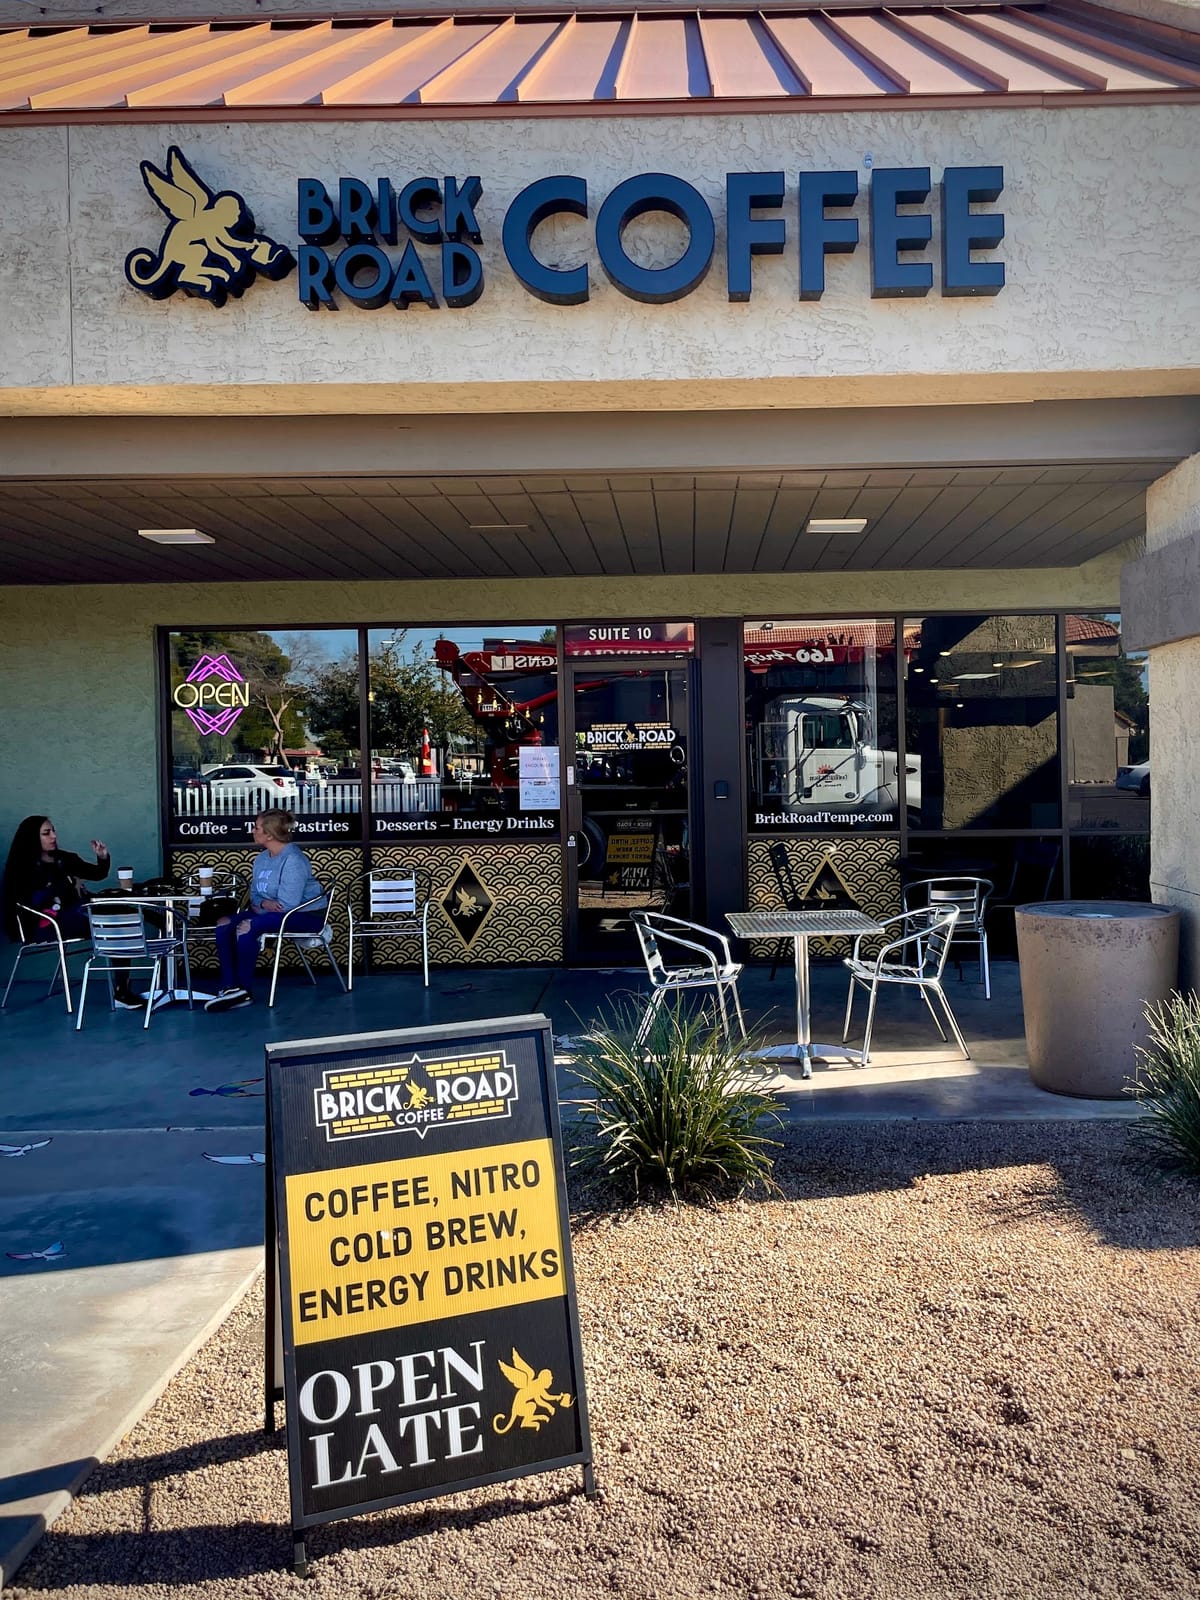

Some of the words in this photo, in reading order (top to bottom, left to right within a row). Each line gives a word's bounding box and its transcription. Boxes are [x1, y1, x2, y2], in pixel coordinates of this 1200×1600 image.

[298, 175, 482, 245] BRICK
[502, 166, 1005, 305] COFFEE
[298, 239, 483, 311] ROAD
[588, 627, 630, 640] SUITE
[637, 627, 652, 639] 10
[174, 682, 250, 708] OPEN
[586, 731, 624, 744] BRICK
[638, 729, 676, 742] ROAD
[179, 822, 228, 835] Coffee
[375, 819, 437, 832] Desserts
[453, 818, 503, 832] Energy
[506, 816, 555, 829] Drinks
[754, 811, 894, 825] BrickRoadTempe.com
[320, 1085, 402, 1120] BRICK
[436, 1072, 513, 1105] ROAD
[395, 1108, 445, 1126] COFFEE
[304, 1176, 440, 1223] COFFEE,
[451, 1159, 540, 1200] NITRO
[330, 1226, 412, 1267] COLD
[426, 1208, 527, 1251] BREW,
[299, 1271, 430, 1323] ENERGY
[444, 1249, 559, 1296] DRINKS
[299, 1340, 486, 1425] OPEN
[308, 1401, 484, 1489] LATE
